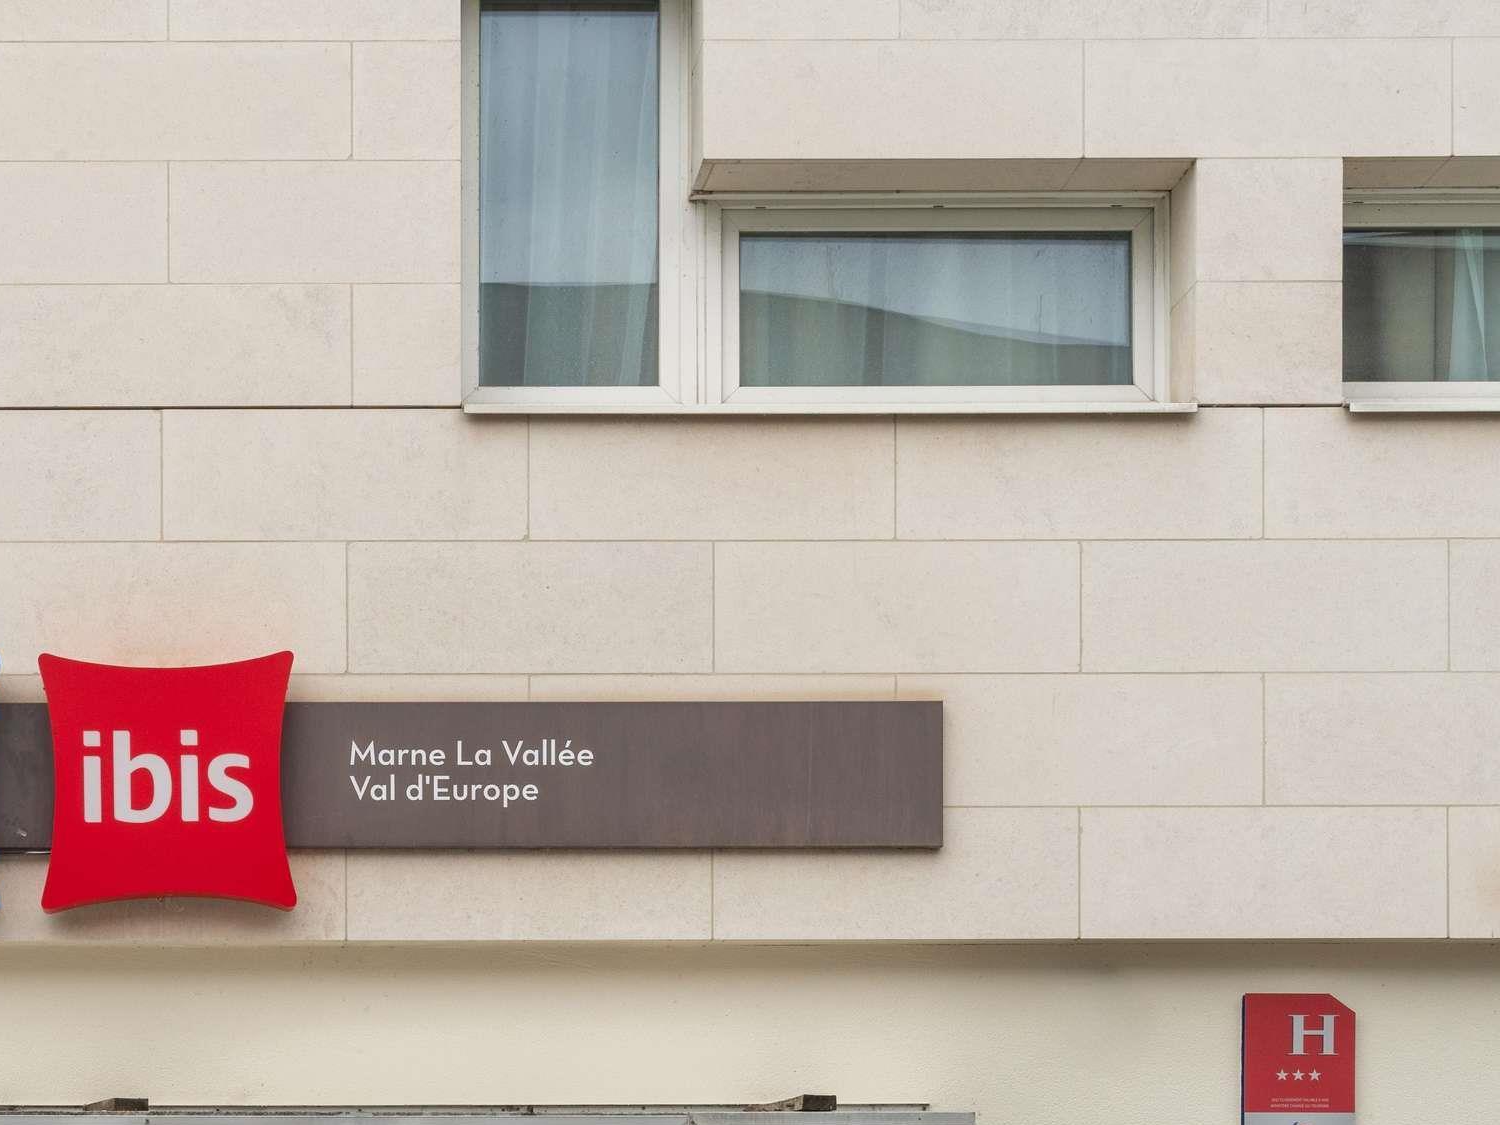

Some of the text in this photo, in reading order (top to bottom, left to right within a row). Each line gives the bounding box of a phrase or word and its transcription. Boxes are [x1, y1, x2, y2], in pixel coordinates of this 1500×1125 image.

[349, 738, 595, 766] Marne La Vallée
[82, 729, 254, 824] ibis
[349, 773, 539, 808] Val d'Europe
[1286, 1014, 1341, 1056] H
